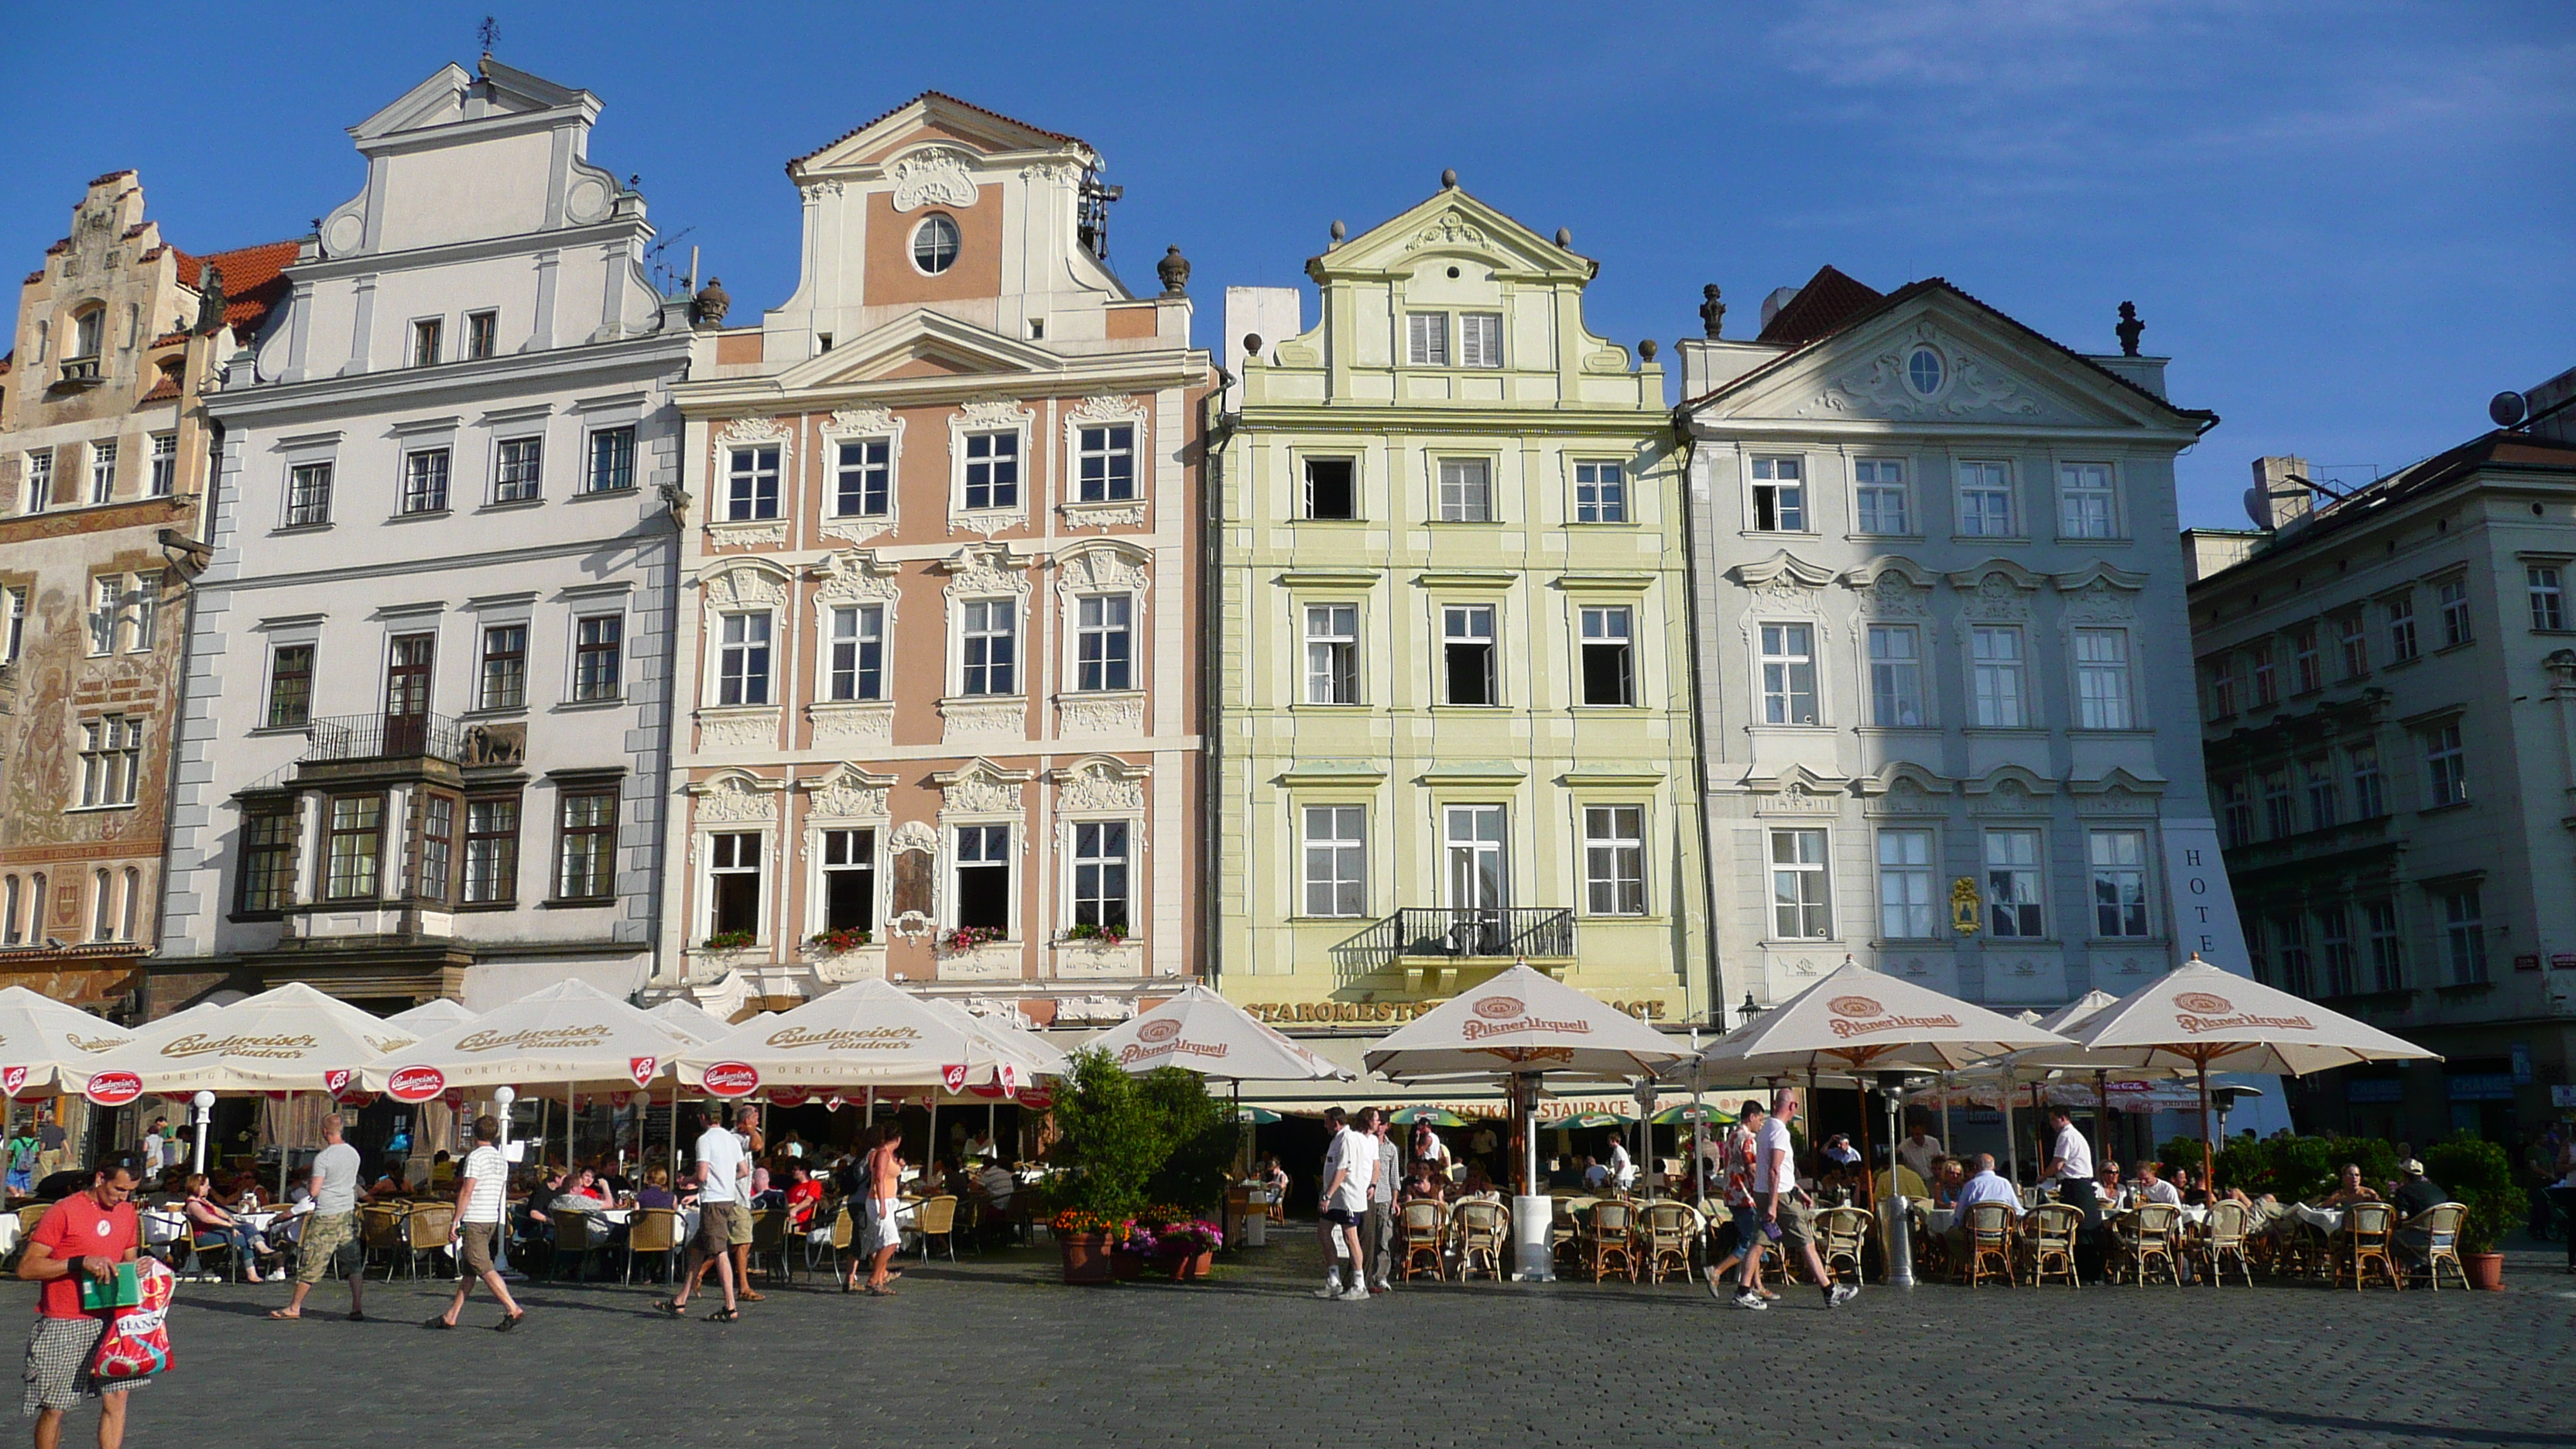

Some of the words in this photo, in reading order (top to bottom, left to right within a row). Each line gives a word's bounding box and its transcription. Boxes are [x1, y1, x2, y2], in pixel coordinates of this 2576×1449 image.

[1463, 1019, 1526, 1040] Pilsner
[1526, 1016, 1593, 1034] Urquell
[1829, 1018, 1893, 1039] Pilsner
[1889, 1013, 1963, 1029] Urquell
[2175, 1013, 2245, 1034] Pilsner
[2239, 1012, 2317, 1029] Urquell
[160, 1033, 318, 1058] Budweiser
[454, 1024, 614, 1052] Budweiser
[517, 1038, 605, 1050] Budvar
[766, 1026, 923, 1050] Budweiser
[827, 1040, 915, 1050] Budvar
[219, 1045, 307, 1059] Budvar
[1120, 1043, 1174, 1064] Pilsner
[1174, 1037, 1229, 1058] Urquell
[163, 1072, 273, 1081] ORIGINAL
[464, 1063, 578, 1075] ORIGINAL
[778, 1066, 890, 1075] ORIGINAL
[391, 1074, 440, 1091] Budweiser
[706, 1070, 755, 1085] Budweiser
[2452, 1077, 2513, 1092] CHANGE
[90, 1078, 139, 1094] Budweiser
